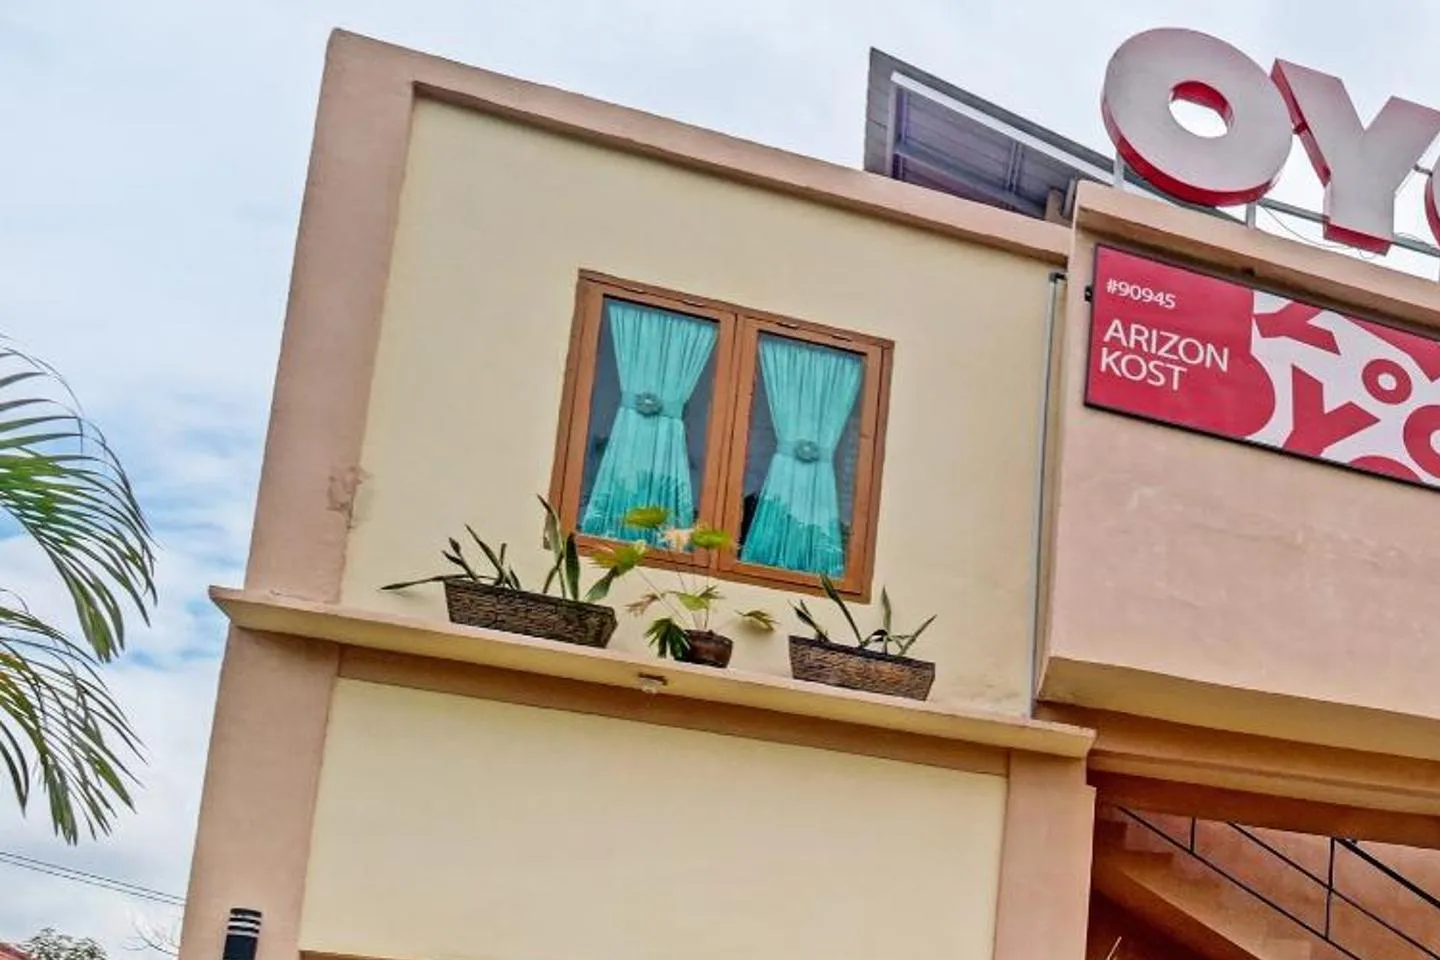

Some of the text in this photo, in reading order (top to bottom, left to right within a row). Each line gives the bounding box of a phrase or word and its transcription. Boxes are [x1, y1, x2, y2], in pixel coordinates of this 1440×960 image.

[1106, 278, 1176, 309] #90945
[1103, 318, 1229, 372] ARIZON
[1100, 347, 1187, 391] KOST
